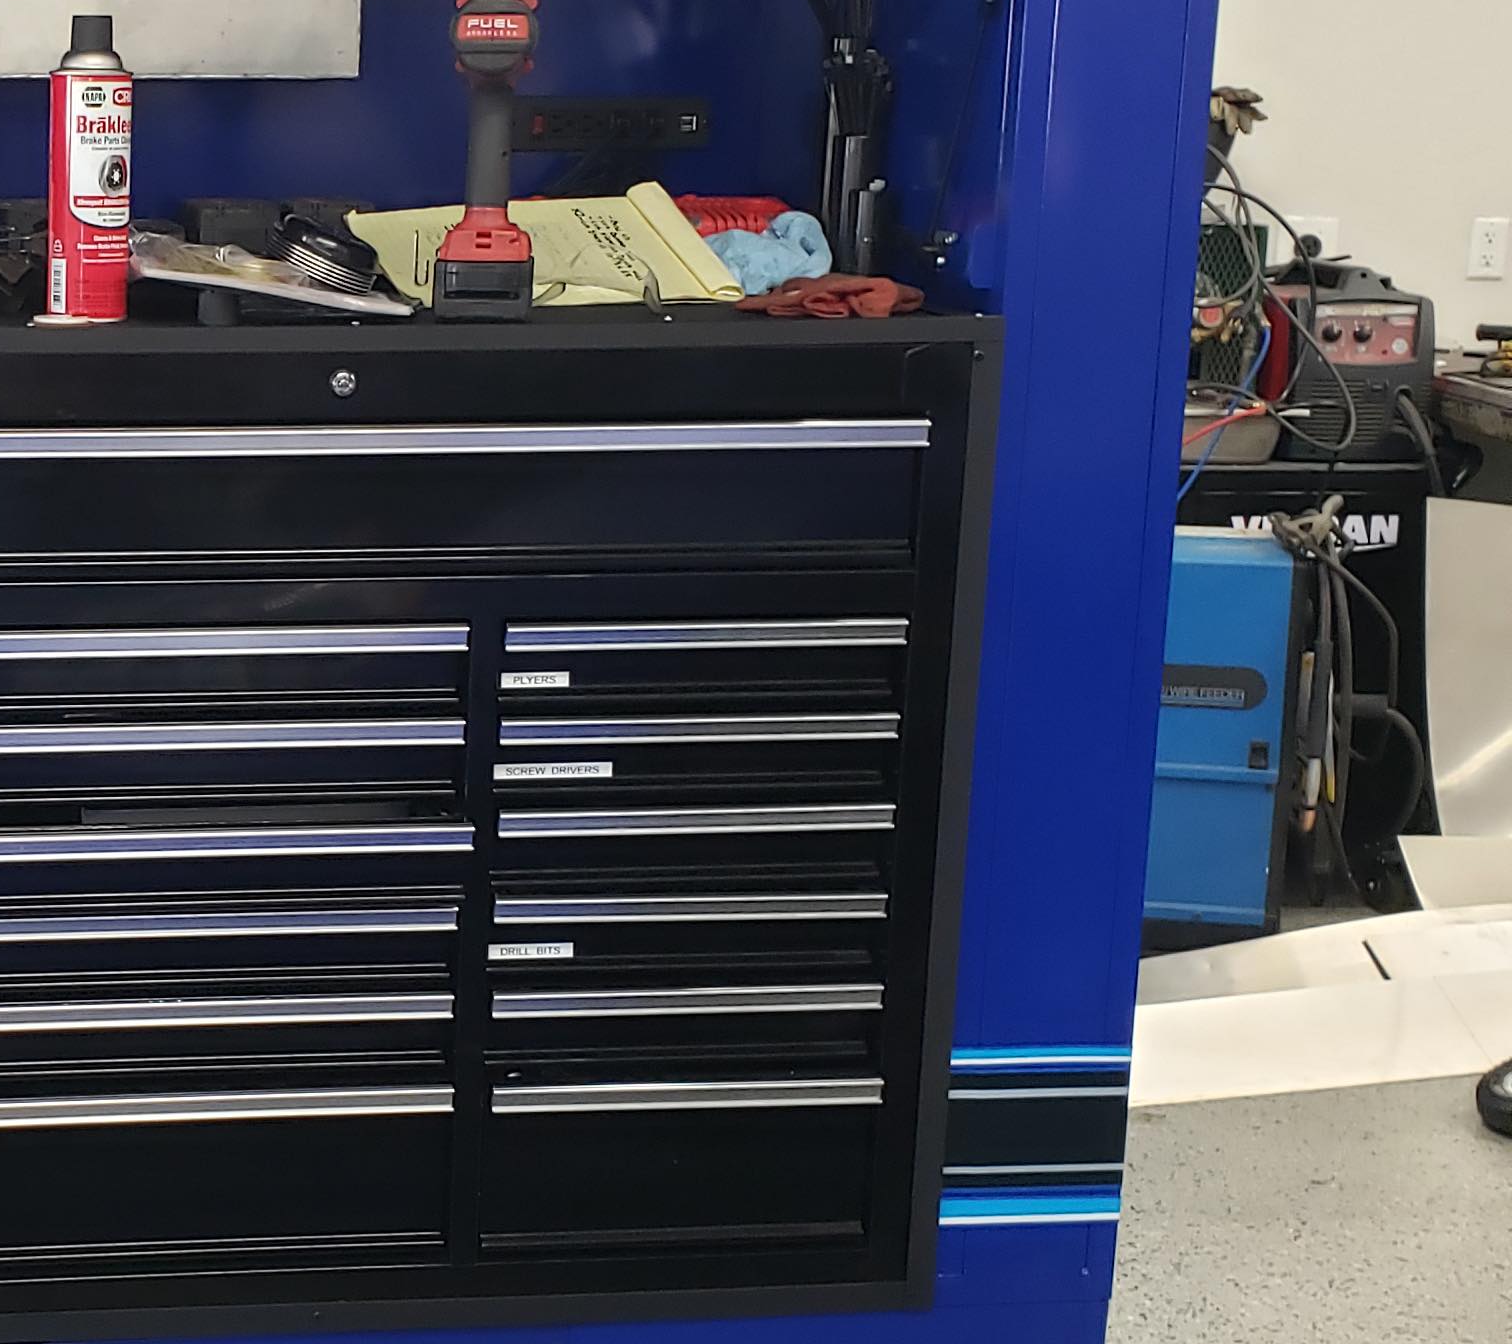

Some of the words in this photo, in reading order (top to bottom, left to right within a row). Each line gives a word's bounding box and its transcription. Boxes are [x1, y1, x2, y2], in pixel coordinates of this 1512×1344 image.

[467, 19, 518, 29] FUEL
[81, 136, 101, 144] Brake
[104, 136, 119, 144] Parts
[513, 676, 556, 684] PLYERS
[505, 766, 546, 776] SCREW
[551, 765, 599, 775] DRIVERS
[500, 947, 528, 956] DRILL
[536, 946, 561, 955] BITS
